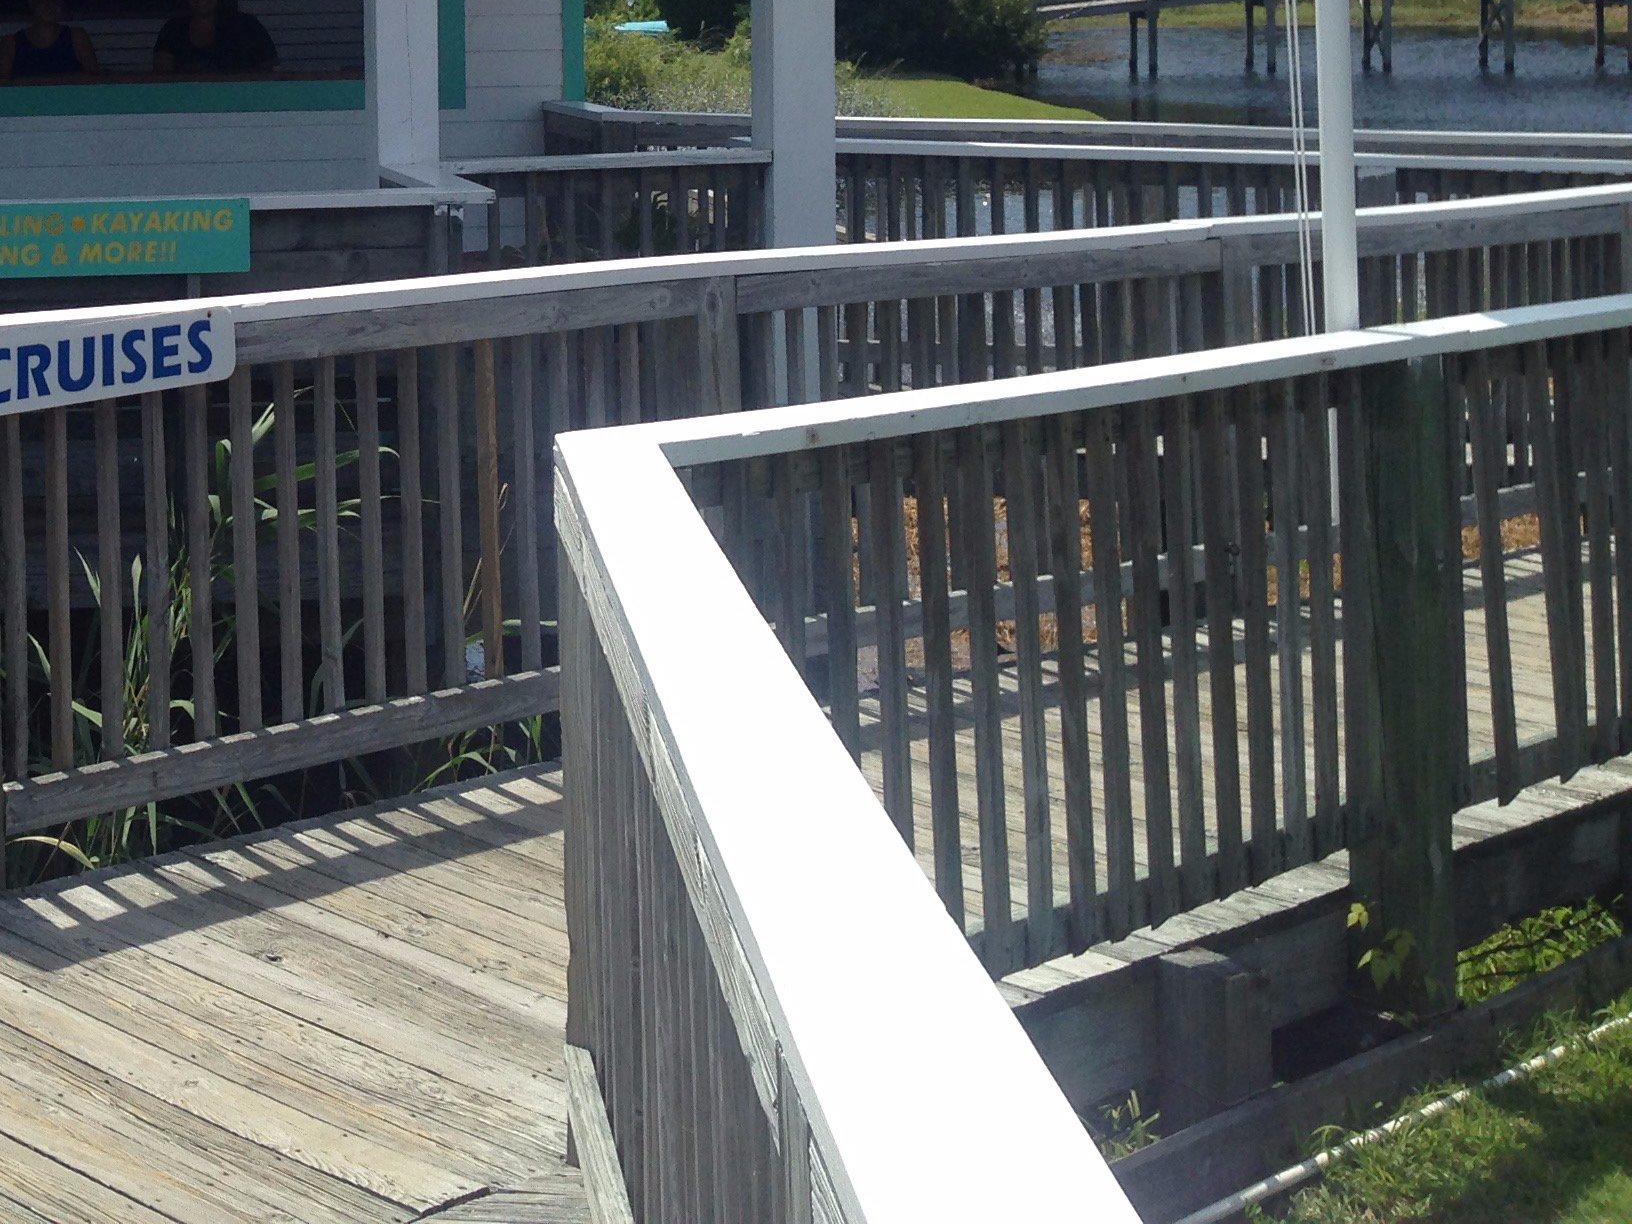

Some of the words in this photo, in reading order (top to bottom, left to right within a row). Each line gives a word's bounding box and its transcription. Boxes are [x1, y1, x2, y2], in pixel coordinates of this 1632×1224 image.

[90, 208, 234, 234] KAYAKING
[51, 242, 68, 266] &
[78, 240, 178, 264] MORE!!
